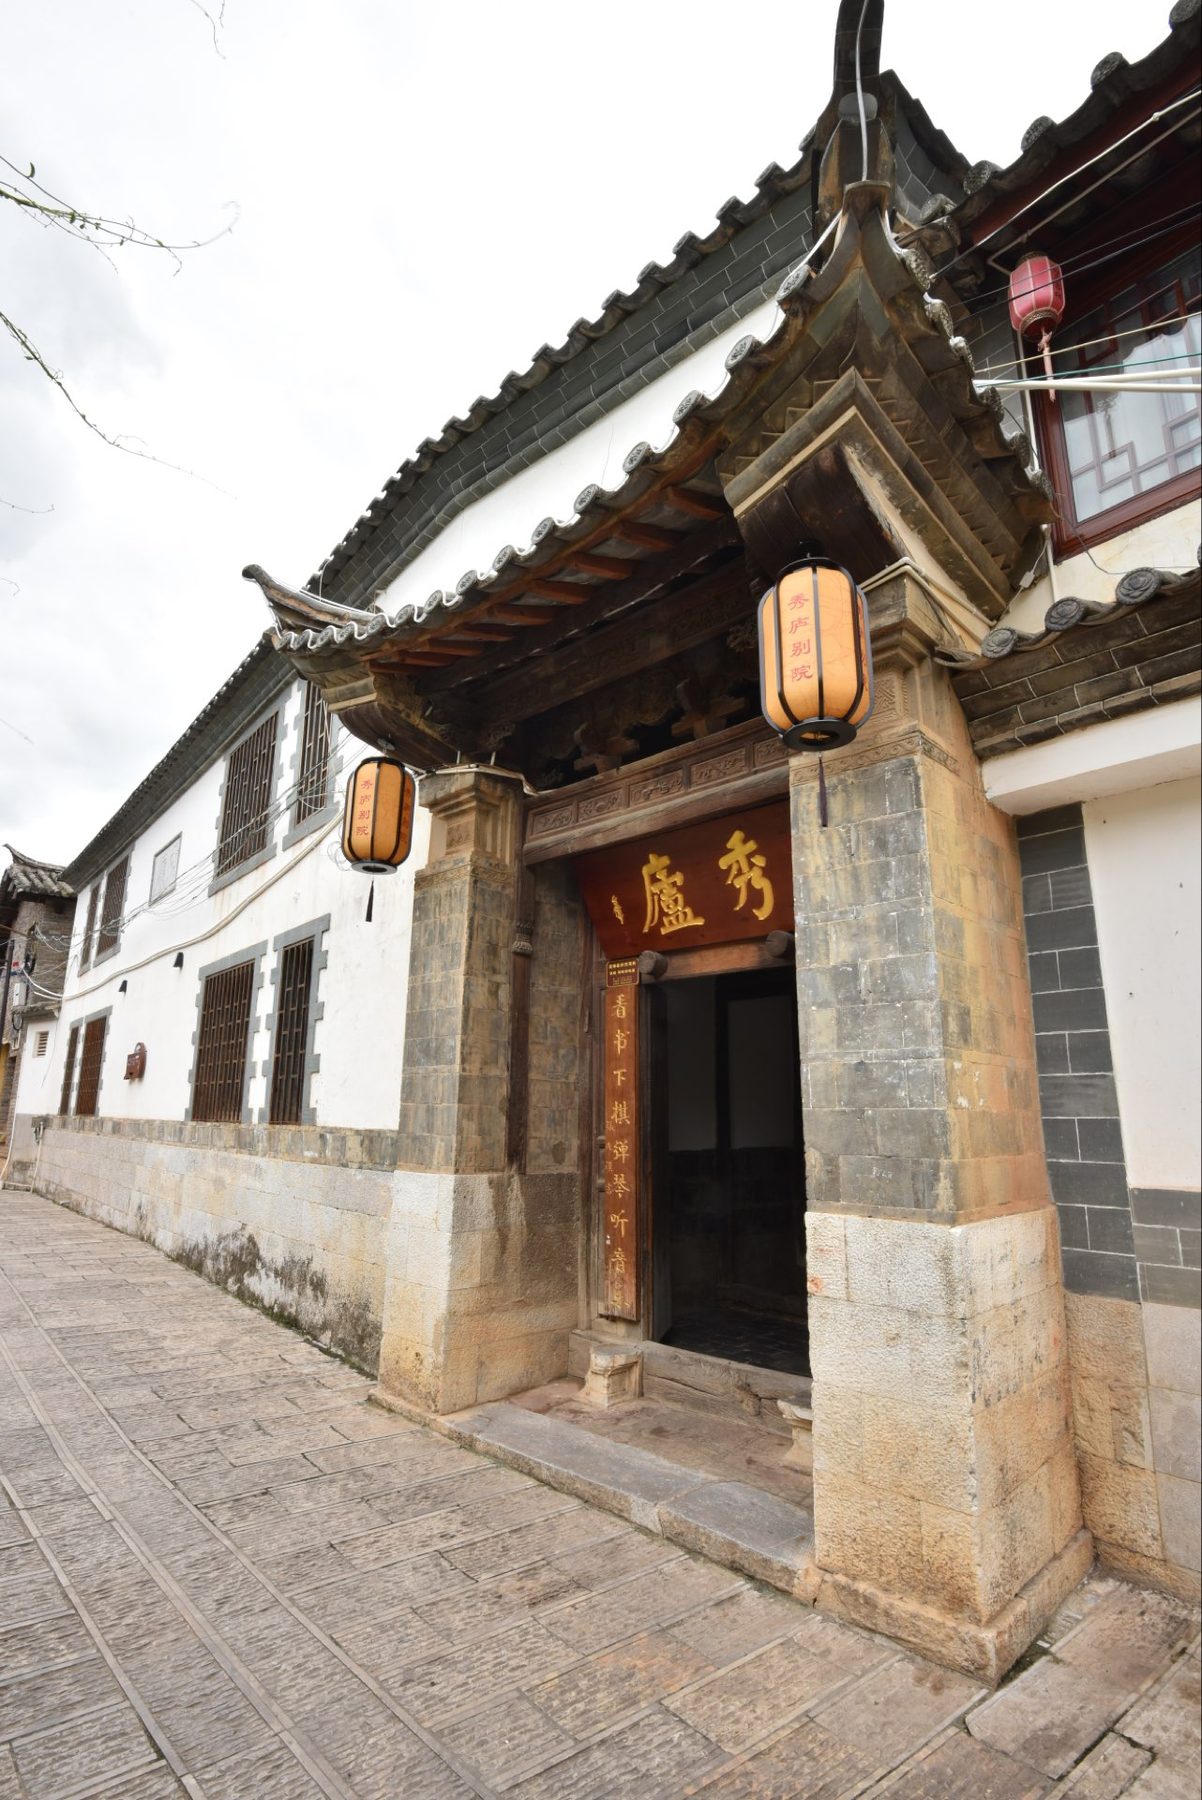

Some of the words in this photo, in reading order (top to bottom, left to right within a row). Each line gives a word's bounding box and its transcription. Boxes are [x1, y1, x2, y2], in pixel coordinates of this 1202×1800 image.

[787, 592, 814, 683] 秀庐别院
[355, 780, 373, 837] 秀庐别院
[641, 829, 775, 936] 秀廬
